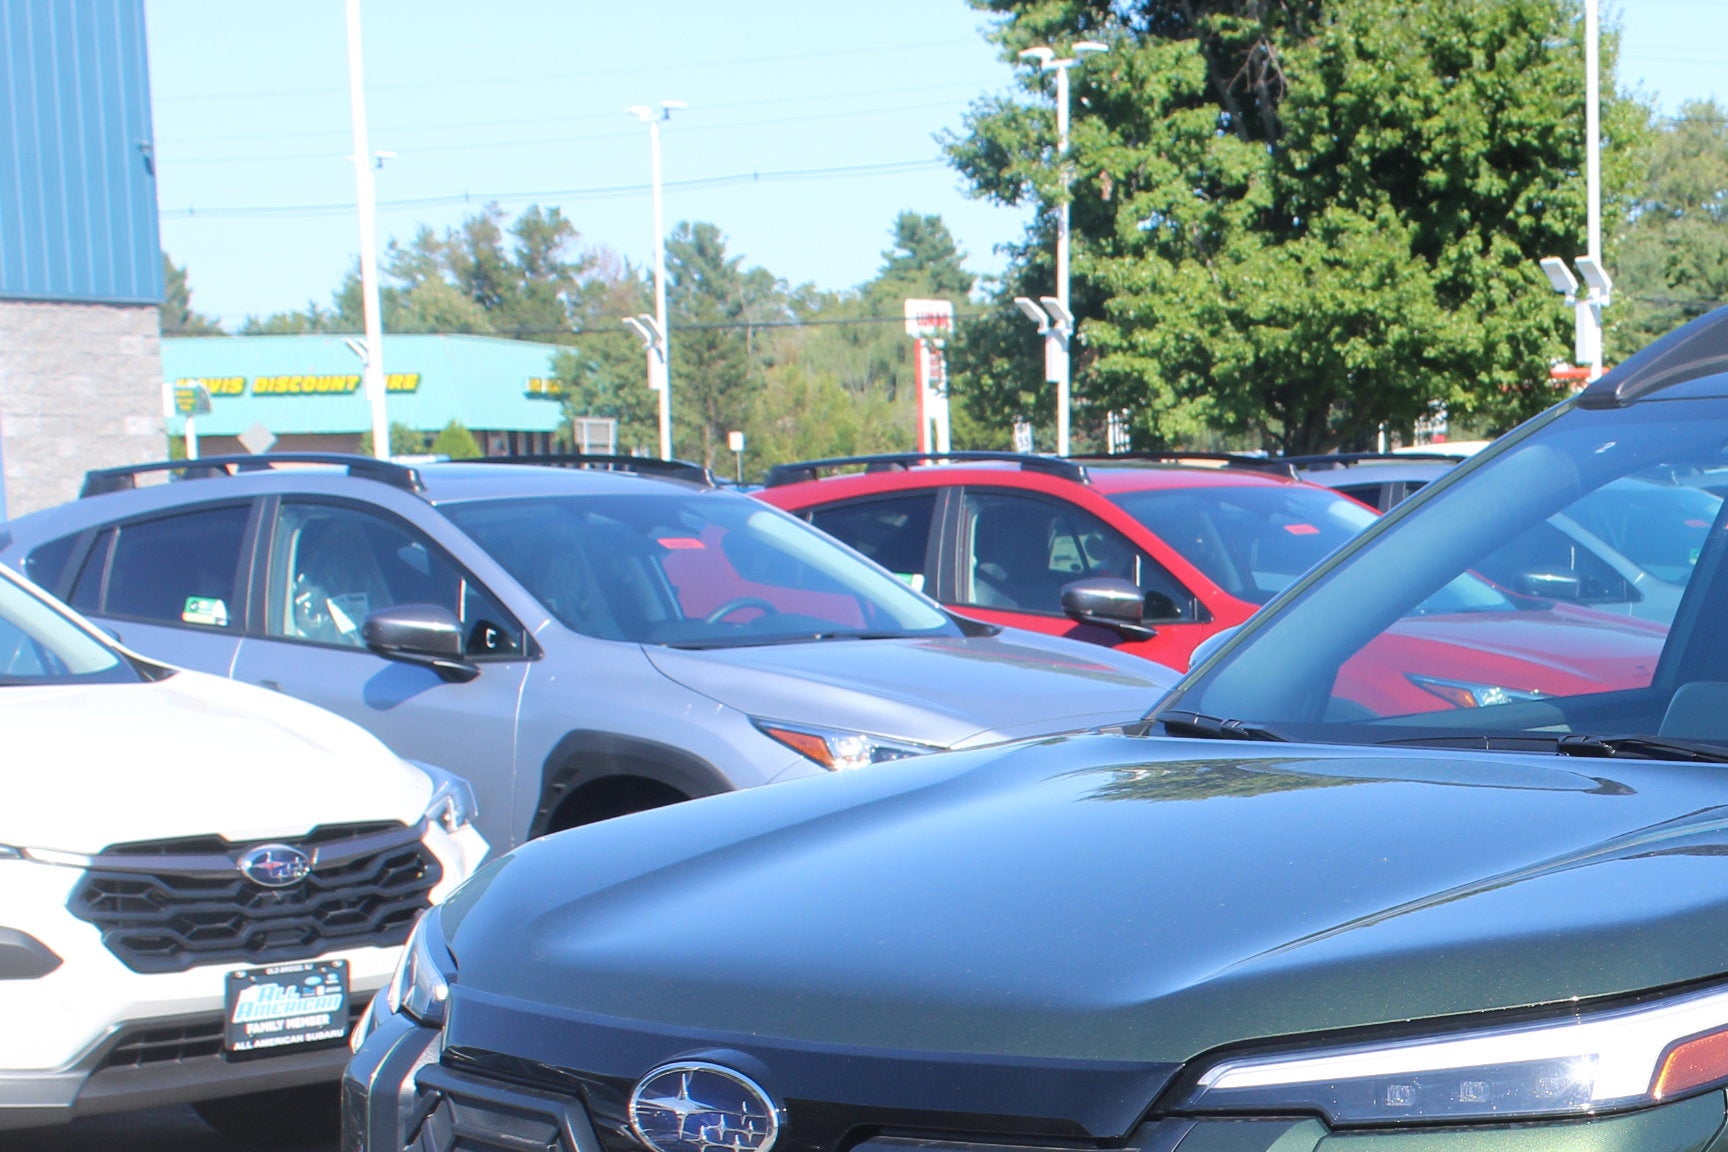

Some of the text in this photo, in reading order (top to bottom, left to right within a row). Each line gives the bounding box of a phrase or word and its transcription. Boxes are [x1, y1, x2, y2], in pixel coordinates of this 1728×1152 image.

[252, 373, 360, 395] DISCOUNT
[258, 982, 301, 1001] ALL
[232, 993, 342, 1023] AMERICAN
[246, 1013, 330, 1035] FAMILY MEMBER
[233, 1028, 344, 1052] ALL AMERICAN SUBARU
